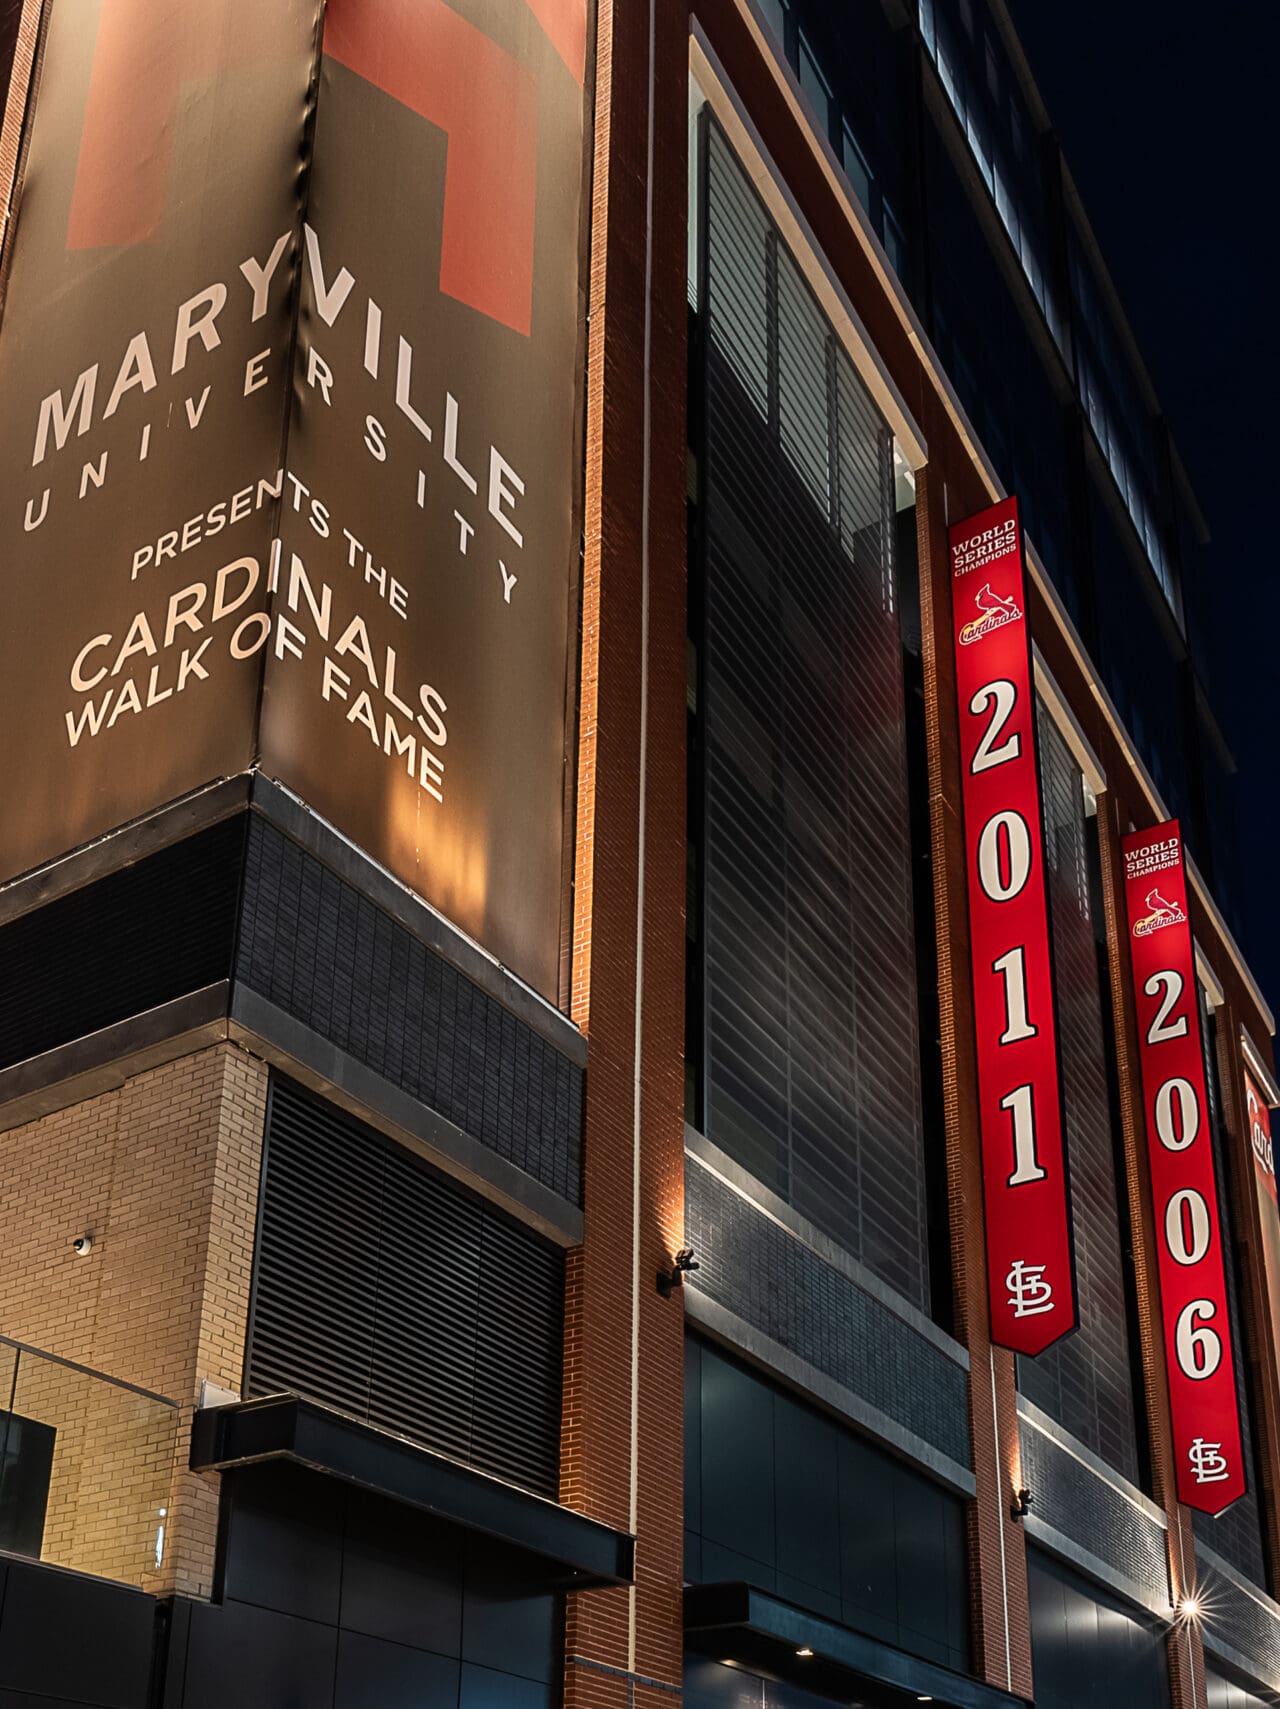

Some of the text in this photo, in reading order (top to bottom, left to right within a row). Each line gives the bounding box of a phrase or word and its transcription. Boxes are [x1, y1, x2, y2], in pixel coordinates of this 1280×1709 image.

[32, 223, 525, 548] MARYVILLE
[24, 347, 518, 604] UNIVERSITY
[131, 468, 408, 620] PRESENTS THE
[952, 519, 1016, 556] WORLD
[954, 531, 1016, 569] SERIES
[954, 543, 1017, 578] CHAMPIONS
[70, 537, 447, 747] CARDINALS
[959, 608, 1023, 646] Cardinals
[65, 613, 444, 803] WALK OF FAME
[1124, 838, 1178, 862] WORLD
[1126, 848, 1179, 872] SERIES
[1127, 858, 1180, 880] CHAMPIONS
[968, 678, 1048, 1188] 2011
[1132, 911, 1186, 938] Cardinals
[1144, 969, 1222, 1380] 2006
